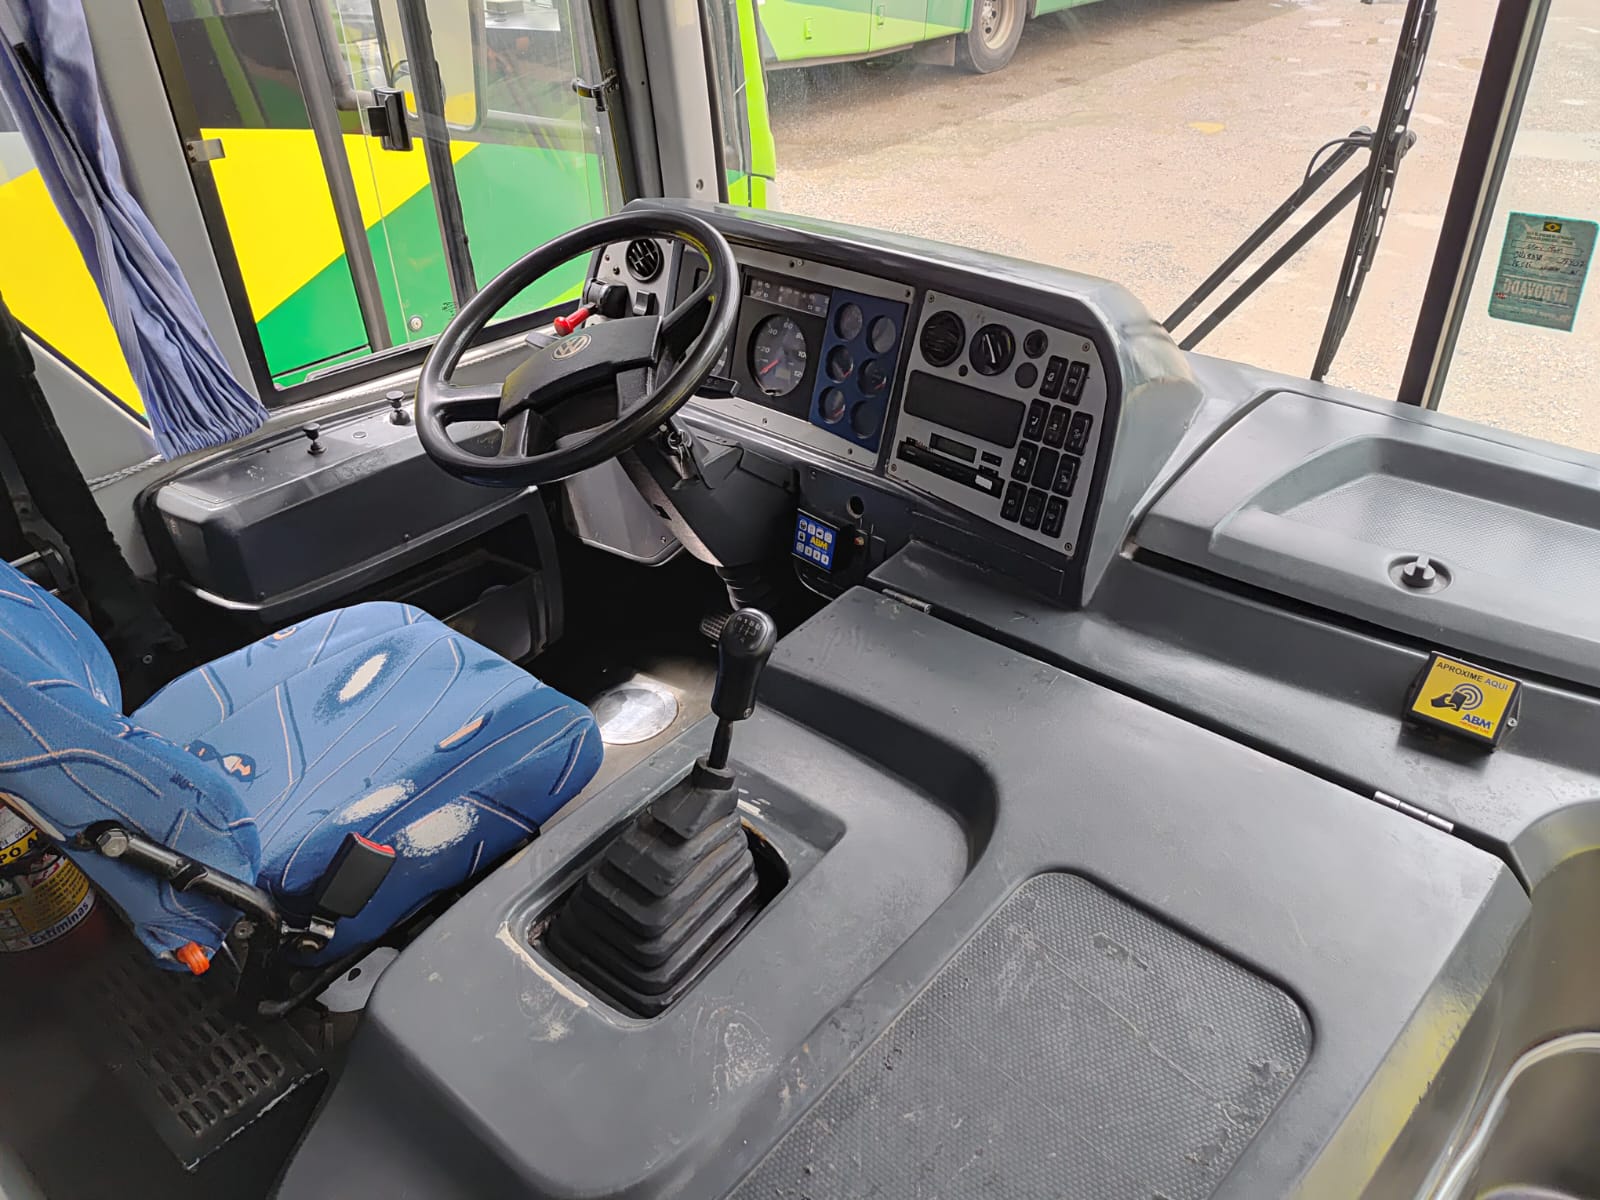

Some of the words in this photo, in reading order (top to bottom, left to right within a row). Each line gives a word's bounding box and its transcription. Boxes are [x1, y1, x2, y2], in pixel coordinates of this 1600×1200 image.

[1436, 661, 1483, 682] APROXIME
[1484, 677, 1509, 691] AQUI
[1462, 713, 1492, 729] ABM
[29, 901, 90, 945] Extiminas
